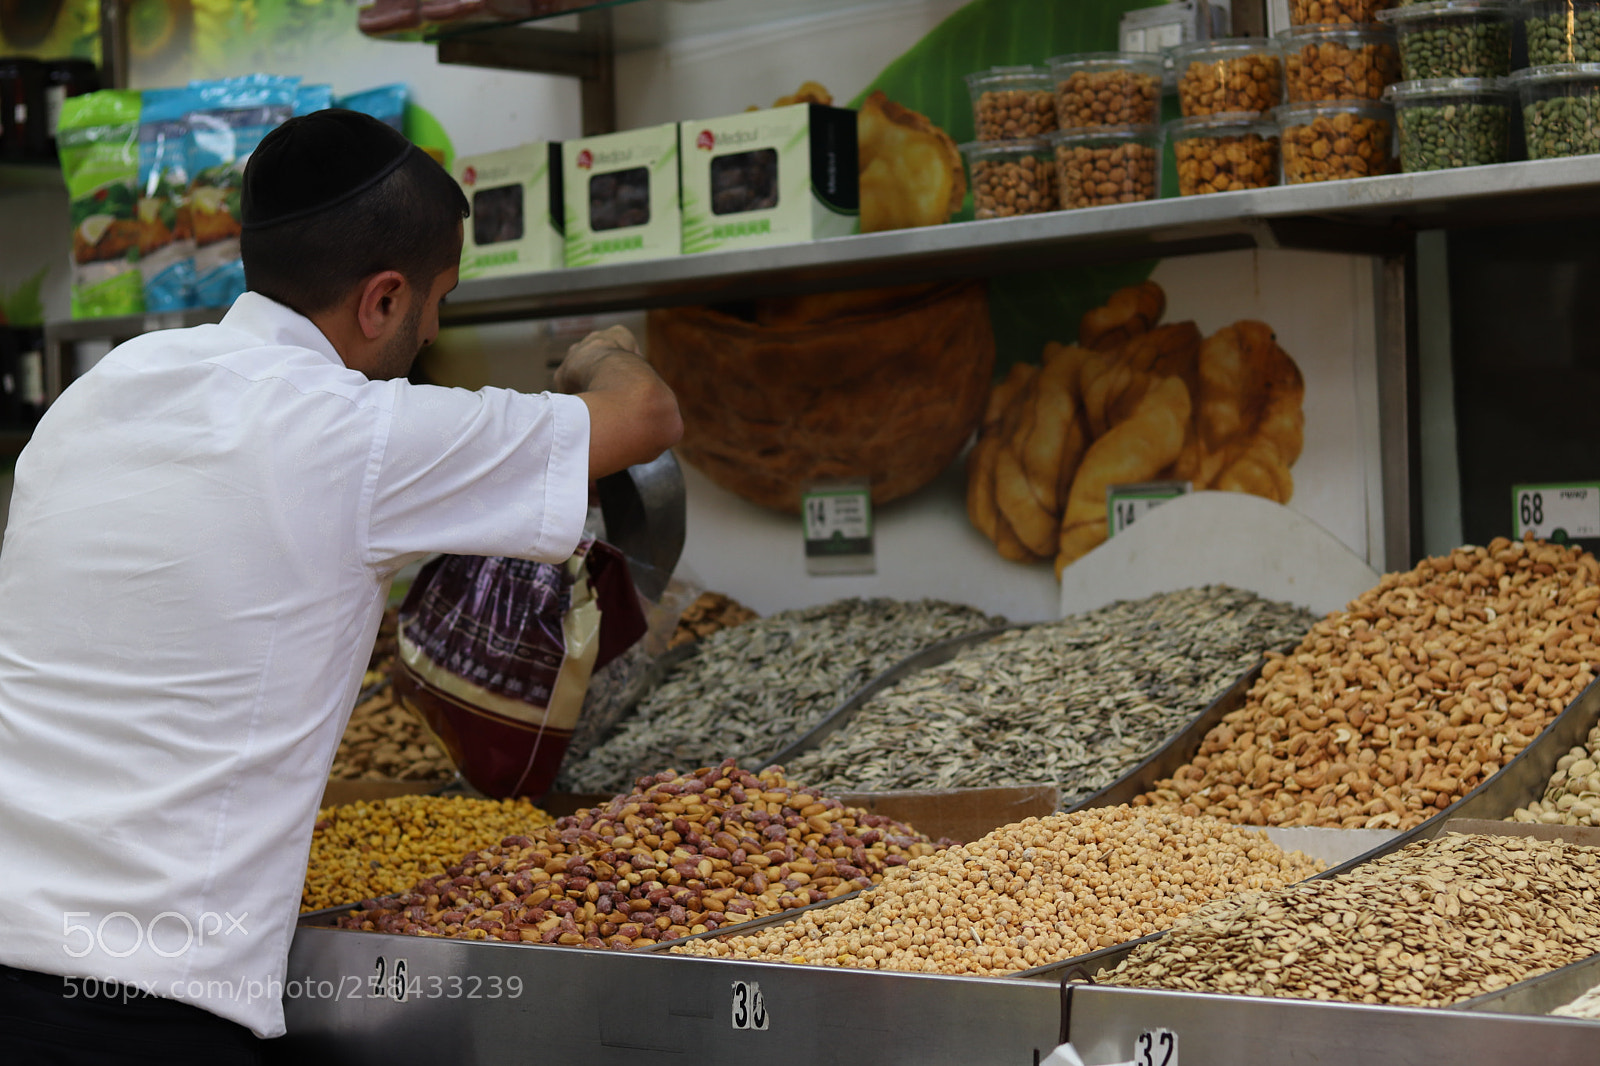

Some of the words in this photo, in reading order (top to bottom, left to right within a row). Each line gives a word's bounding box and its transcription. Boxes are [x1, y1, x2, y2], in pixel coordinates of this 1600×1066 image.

[809, 498, 826, 528] 14
[1117, 502, 1135, 530] 14
[1521, 492, 1543, 525] 68
[375, 956, 406, 1000] 26
[1139, 1032, 1174, 1066] 32
